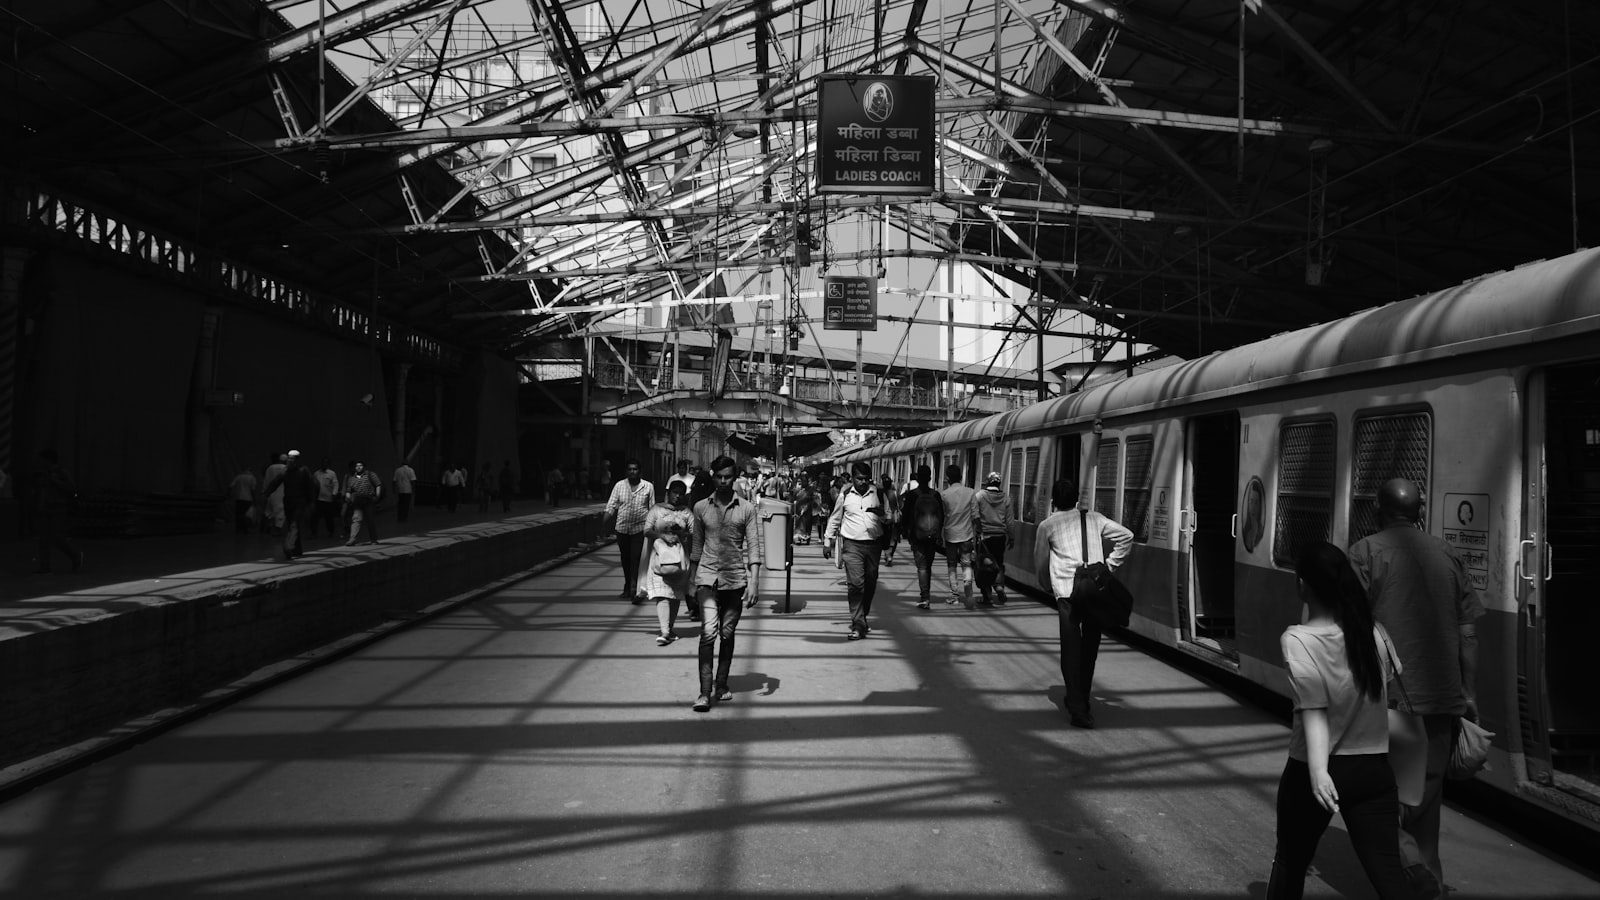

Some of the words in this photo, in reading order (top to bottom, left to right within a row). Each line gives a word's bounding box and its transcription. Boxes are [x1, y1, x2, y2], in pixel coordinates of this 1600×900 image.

[837, 123, 882, 140] महिला
[886, 127, 919, 140] डब्बा
[834, 145, 879, 163] महिला
[883, 146, 922, 163] डिब्बा
[835, 170, 877, 181] LADIES
[880, 170, 921, 182] COACH
